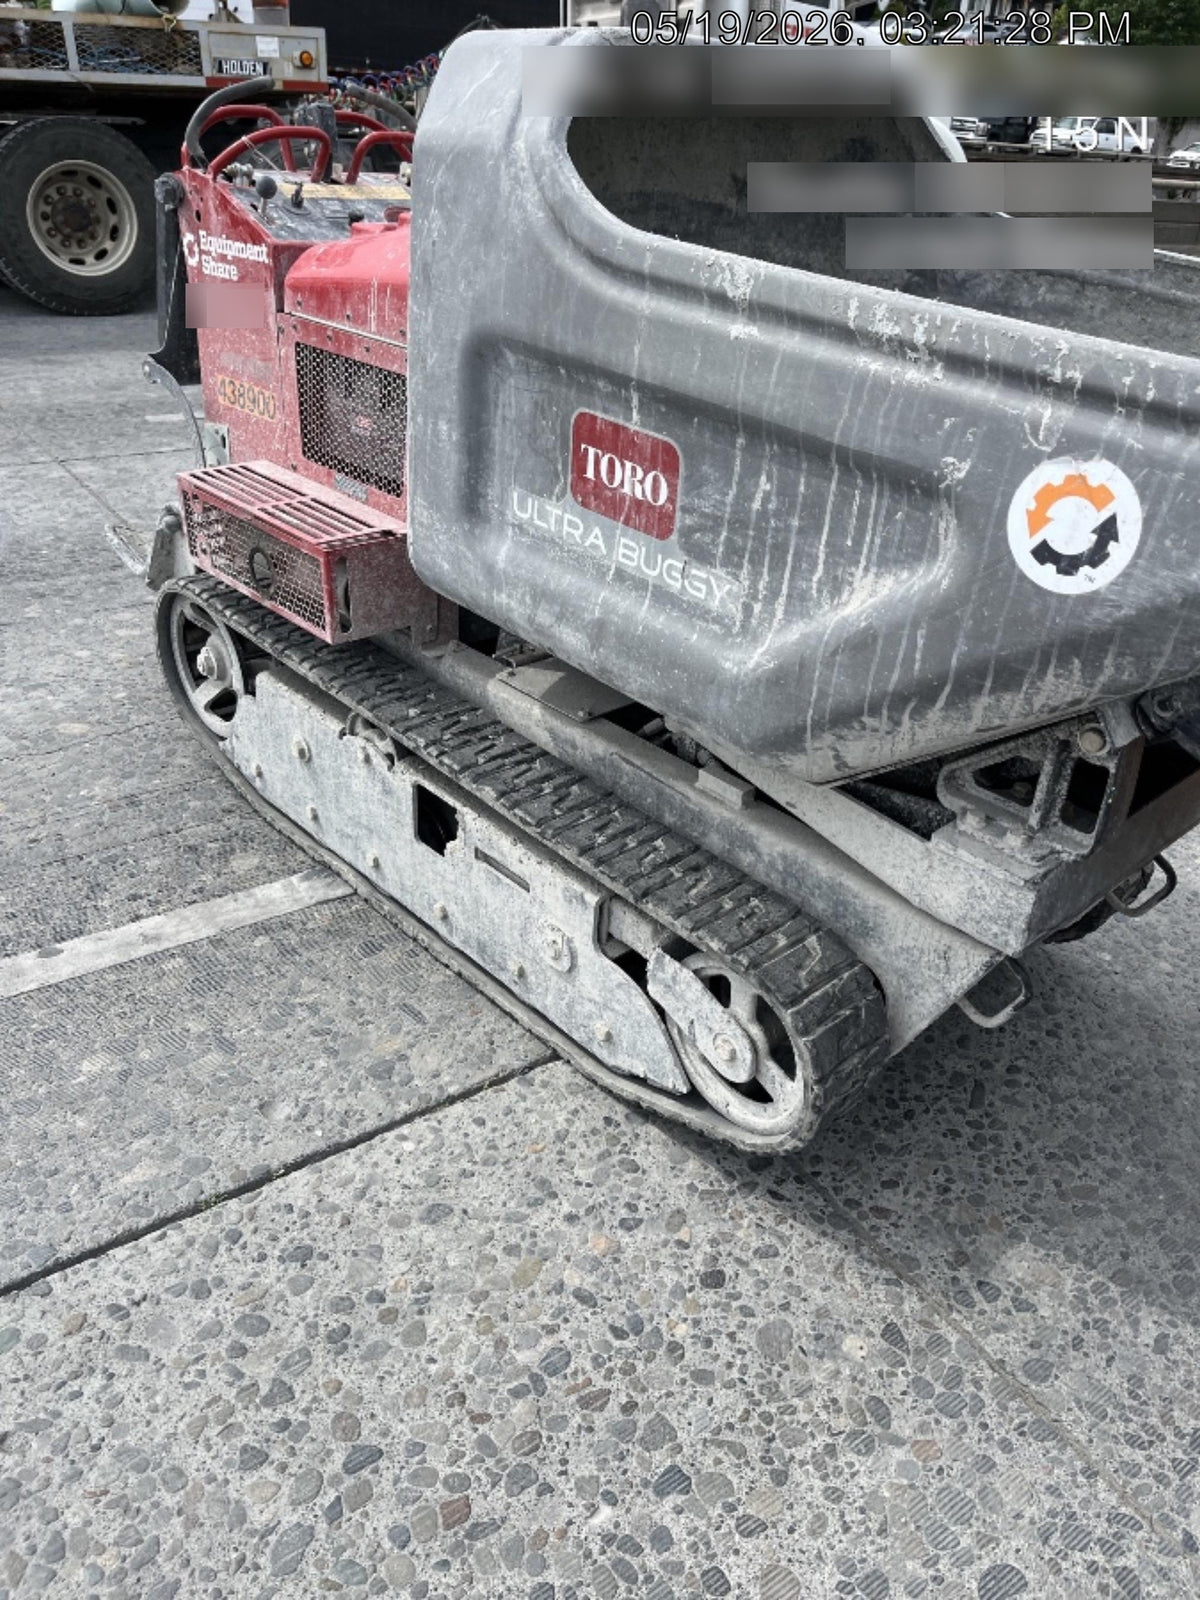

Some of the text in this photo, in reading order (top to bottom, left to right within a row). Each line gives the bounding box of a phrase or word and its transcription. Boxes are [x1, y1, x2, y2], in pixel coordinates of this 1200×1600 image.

[222, 59, 264, 76] HOLDEN
[199, 229, 269, 264] Equipment
[201, 253, 238, 281] Share
[218, 377, 277, 420] 438900
[581, 444, 668, 506] TORO
[513, 491, 731, 605] ULTRA BUGGY
